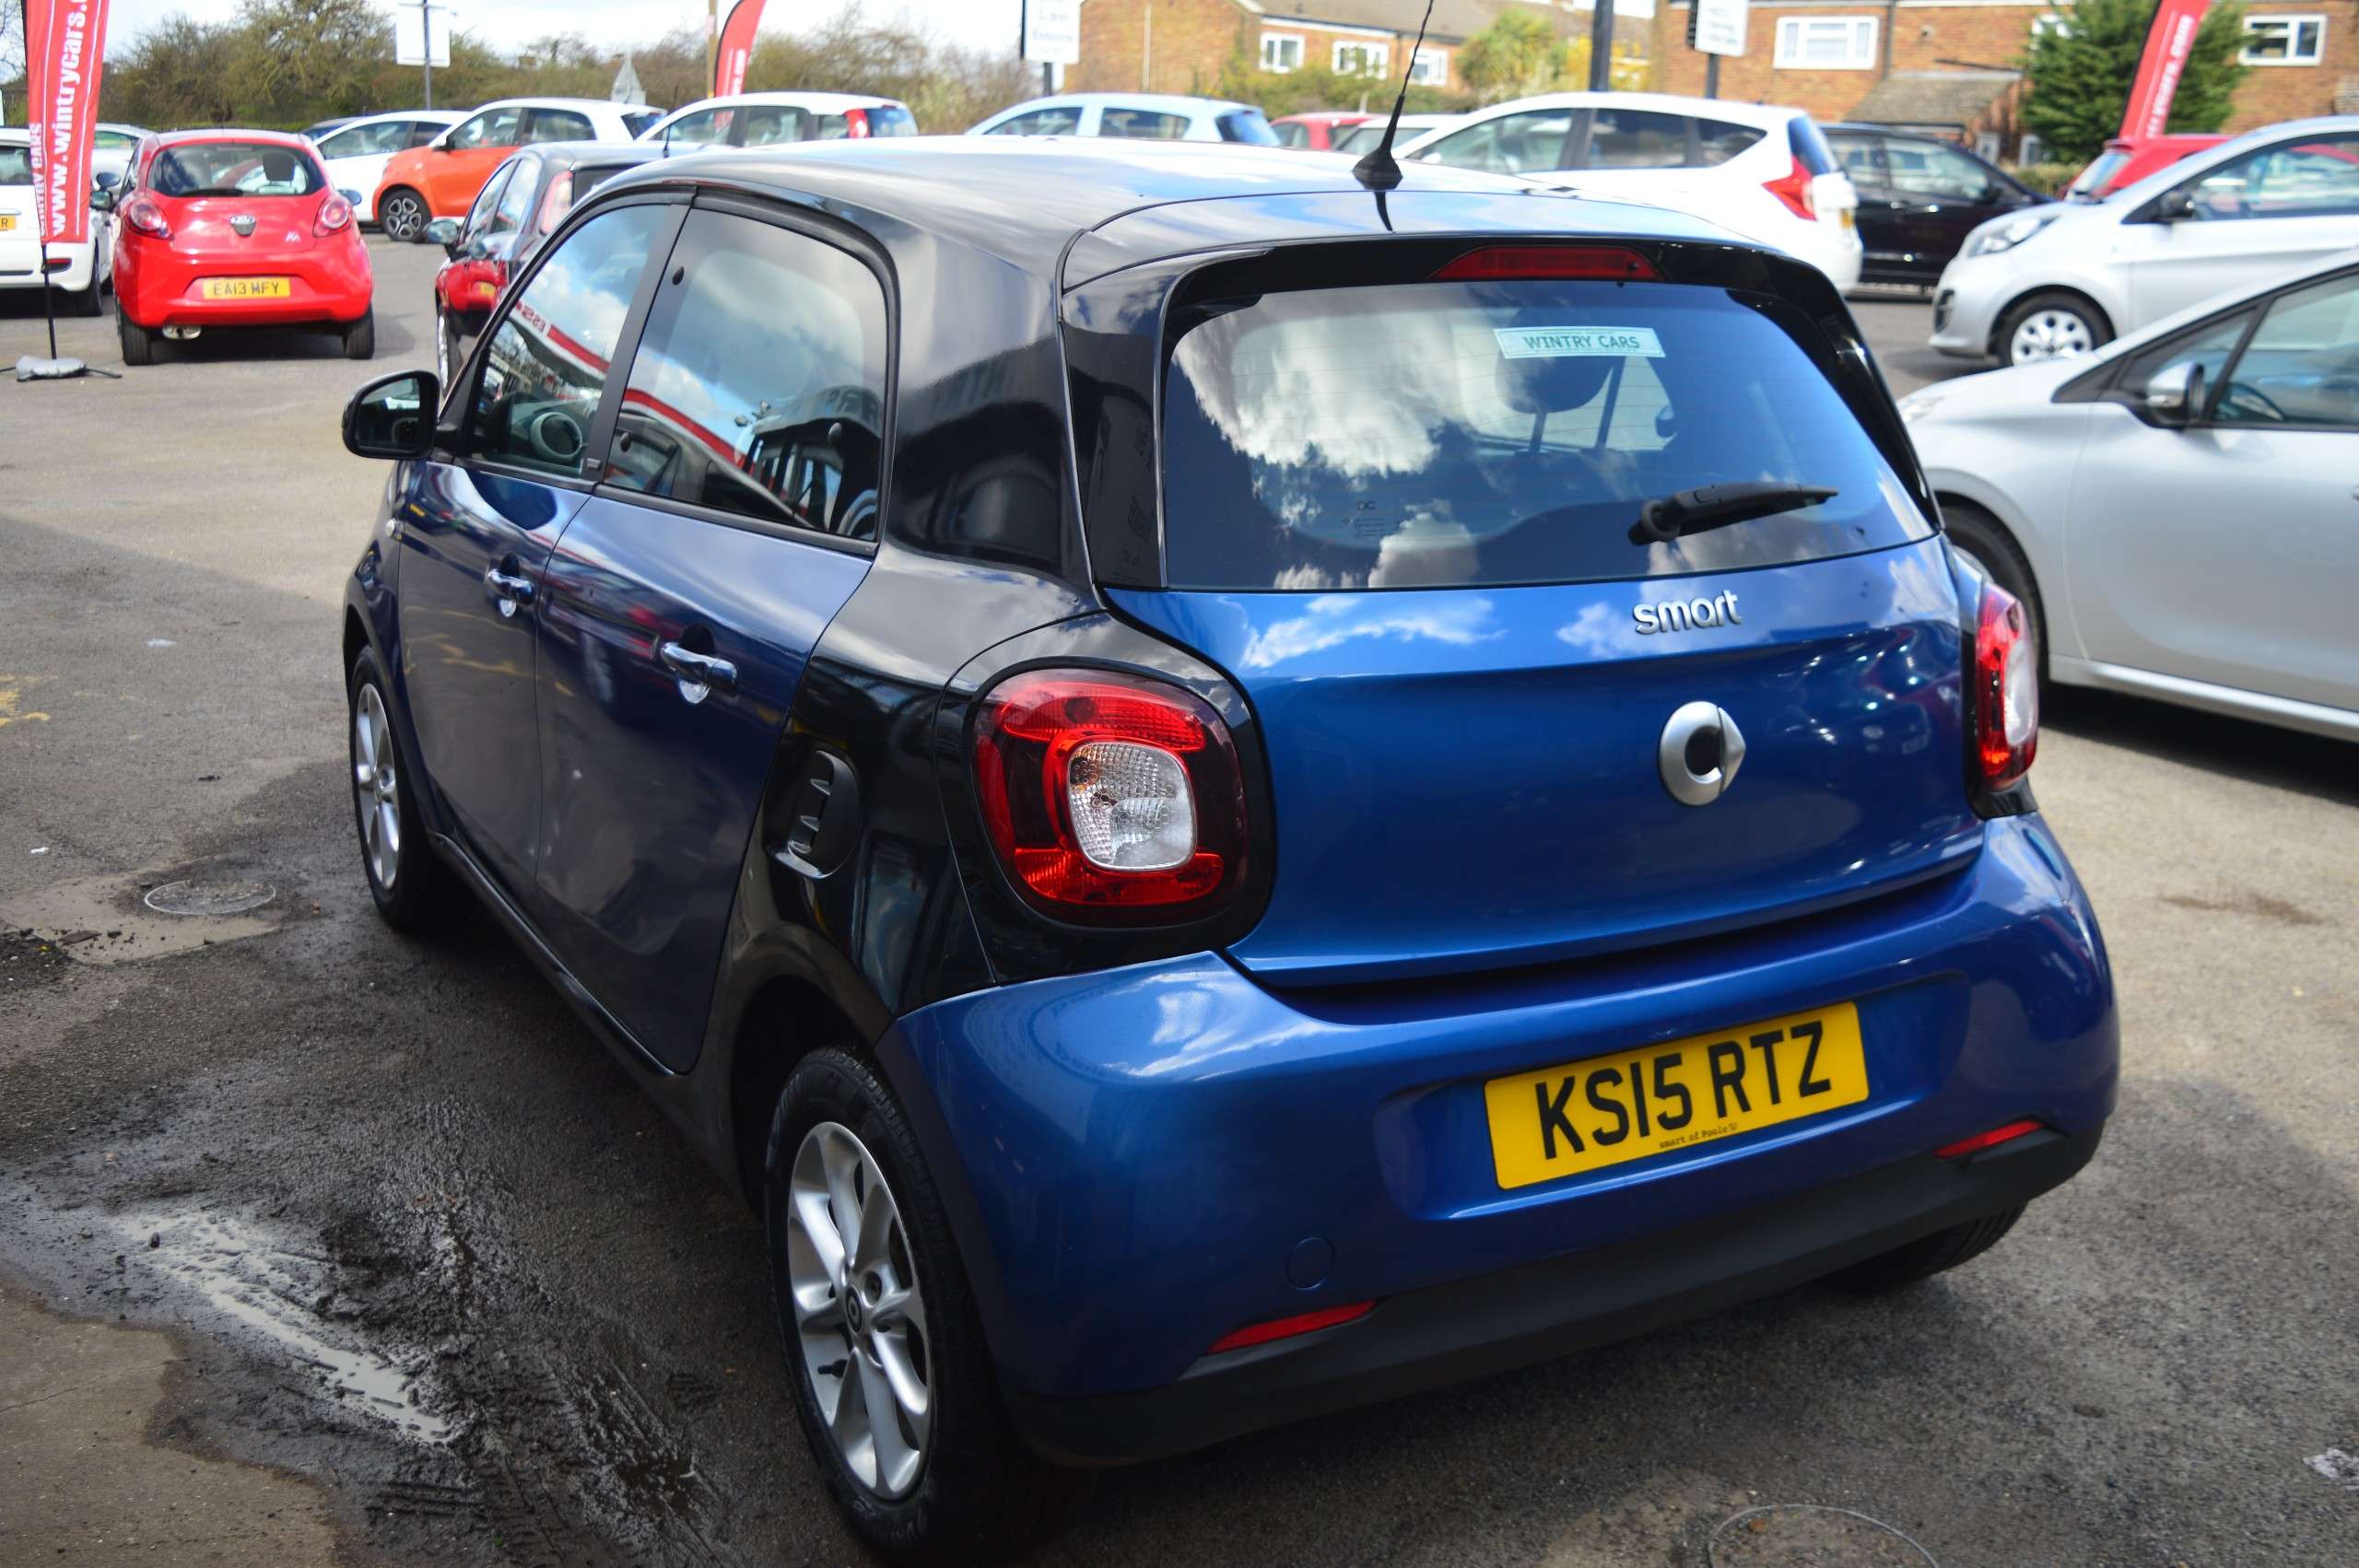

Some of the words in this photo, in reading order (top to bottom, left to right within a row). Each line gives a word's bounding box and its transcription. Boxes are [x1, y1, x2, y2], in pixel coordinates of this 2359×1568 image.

[51, 0, 88, 237] www.wintrycars.
[29, 123, 42, 169] CARS
[213, 281, 247, 296] EA13
[251, 280, 279, 295] MFY
[1523, 335, 1592, 349] WINTRY
[1598, 334, 1641, 349] CARS
[1633, 589, 1743, 635] smart
[1535, 1052, 1694, 1161] KS15
[1708, 1019, 1832, 1119] RTZ
[1660, 1136, 1685, 1148] smart
[1688, 1130, 1699, 1141] of
[1702, 1125, 1729, 1138] Poole
